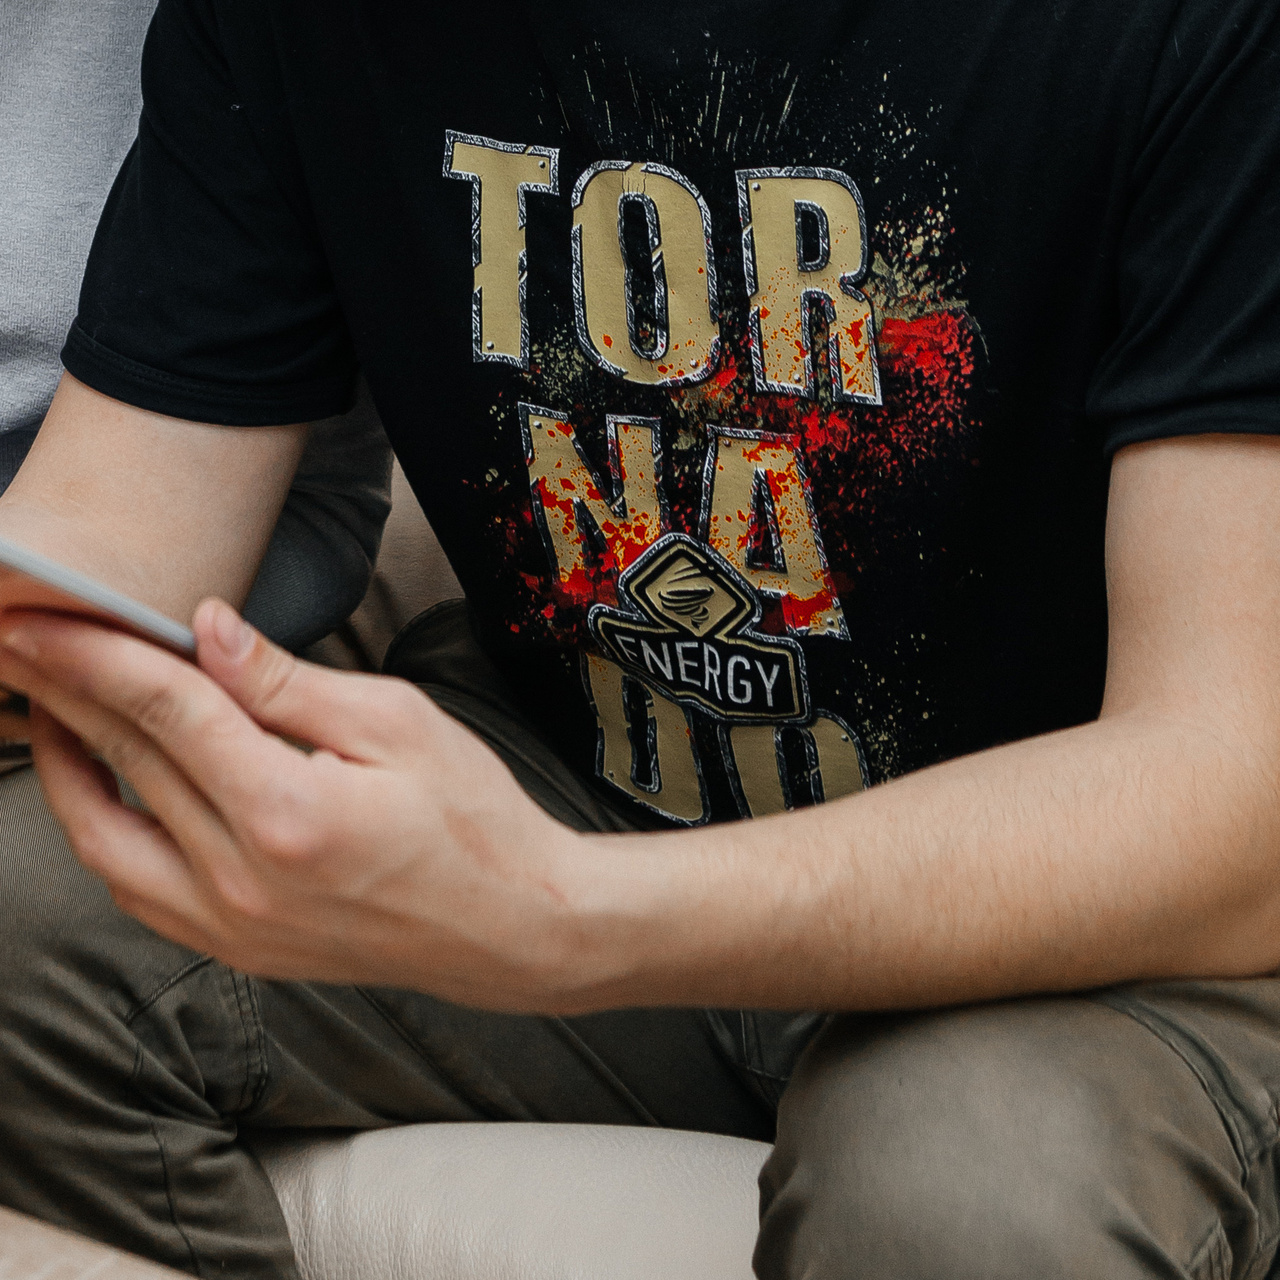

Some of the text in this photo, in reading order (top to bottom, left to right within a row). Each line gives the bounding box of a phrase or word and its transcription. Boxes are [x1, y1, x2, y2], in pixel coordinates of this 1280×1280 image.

[441, 129, 884, 407] TOR
[517, 402, 851, 642] NA
[613, 632, 782, 709] ENERGY
